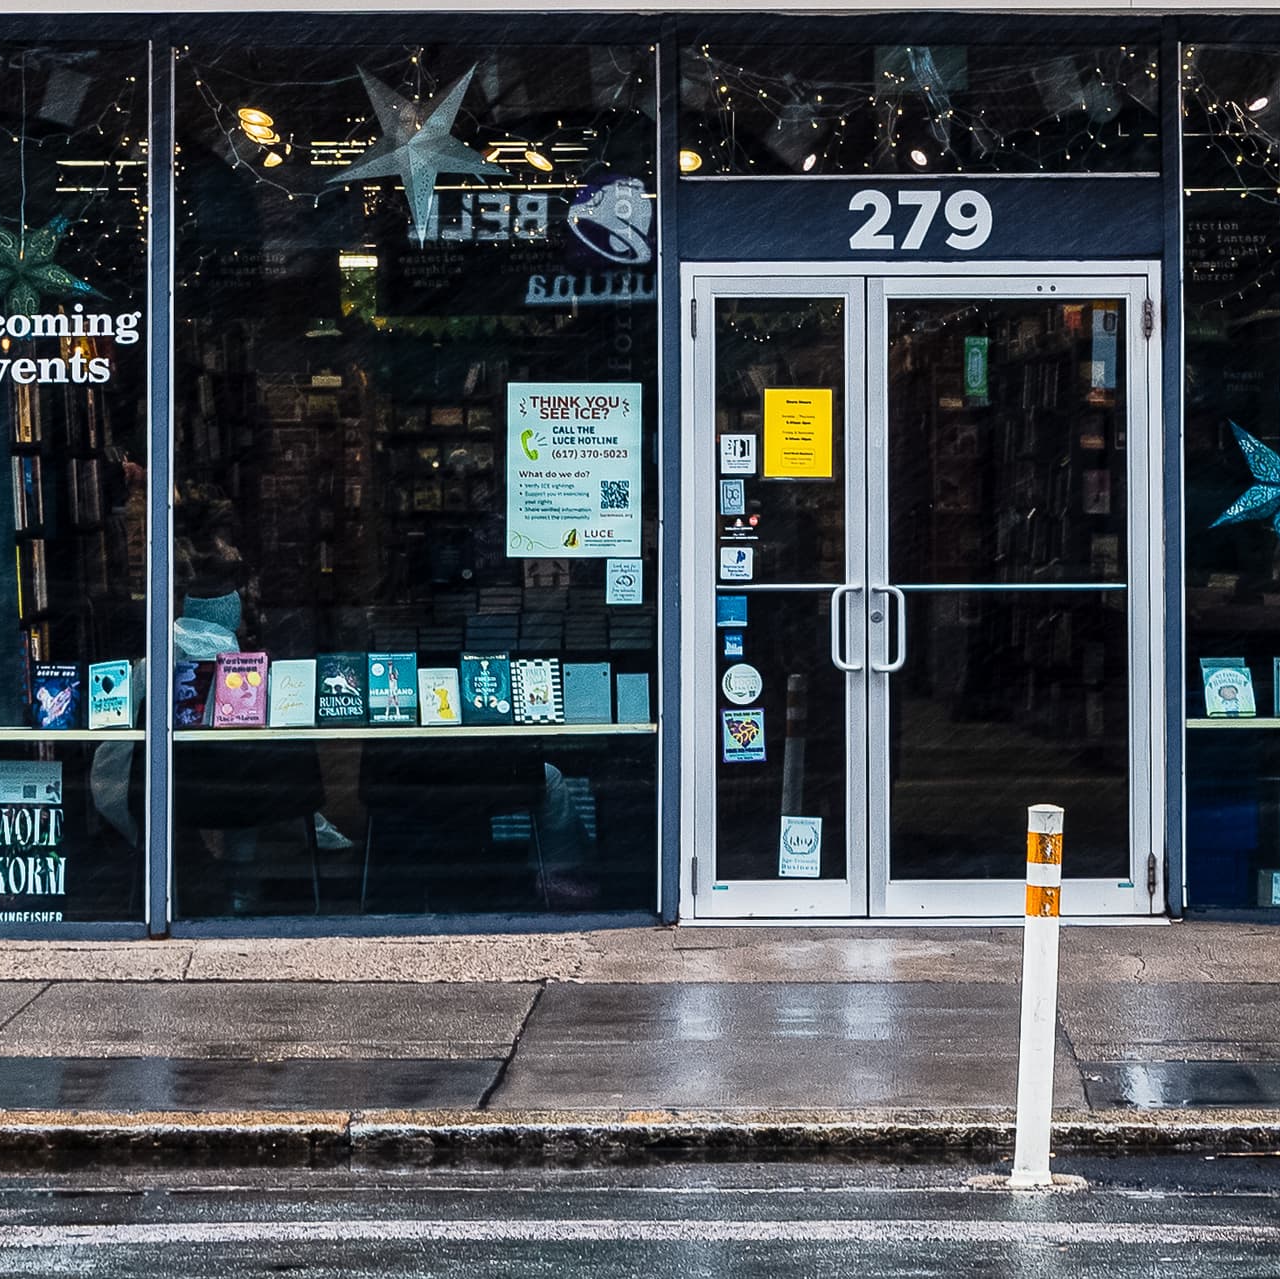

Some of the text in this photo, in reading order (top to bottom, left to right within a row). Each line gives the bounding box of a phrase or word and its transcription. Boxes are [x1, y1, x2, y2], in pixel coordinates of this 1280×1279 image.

[848, 189, 993, 250] 279
[529, 396, 620, 408] THINK YOU
[539, 407, 610, 420] SEE ICE?
[552, 426, 595, 434] CALL THE
[552, 436, 618, 445] LUCE HOTLINE
[552, 449, 578, 459] (617)
[519, 470, 543, 479] What
[545, 470, 557, 479] do
[574, 470, 590, 479] do?
[584, 529, 614, 538] LUCE
[217, 656, 264, 665] Westward
[319, 696, 363, 707] RUINOUS
[318, 706, 364, 717] CREATURES
